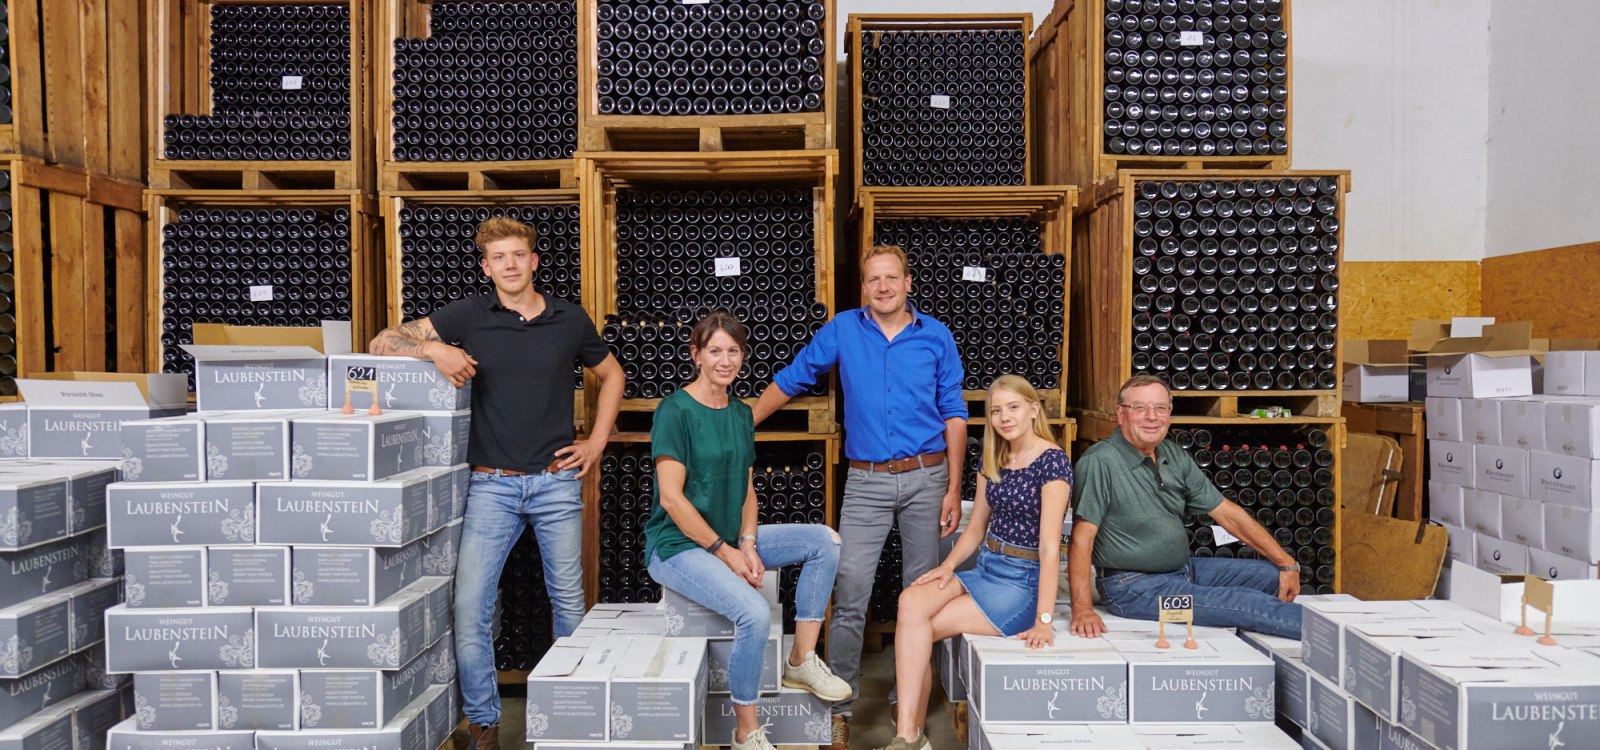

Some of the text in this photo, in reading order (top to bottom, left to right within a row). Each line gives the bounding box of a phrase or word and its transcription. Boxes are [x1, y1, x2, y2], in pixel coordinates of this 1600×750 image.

[214, 368, 305, 383] LAUBENSTEIN
[347, 366, 374, 380] 621
[379, 371, 435, 384] ENSTEIN
[160, 491, 194, 499] WEINGUT
[311, 490, 345, 498] WEINGUT
[127, 499, 229, 515] LAUBENSTEIN
[277, 498, 379, 513] LAUBENSTEIN
[11, 543, 79, 575] LAUBENSTEIN
[1163, 596, 1190, 609] 603
[125, 624, 228, 641] LAUBENSTEIN
[274, 623, 375, 638] LAUBENSTEIN
[1036, 668, 1070, 676] WEINGUT
[1003, 676, 1104, 691] LAUBENSTEIN
[1152, 676, 1253, 691] LAUBENSTEIN
[1534, 691, 1578, 701] WEINGUT
[721, 703, 811, 717] LAENSTEIN
